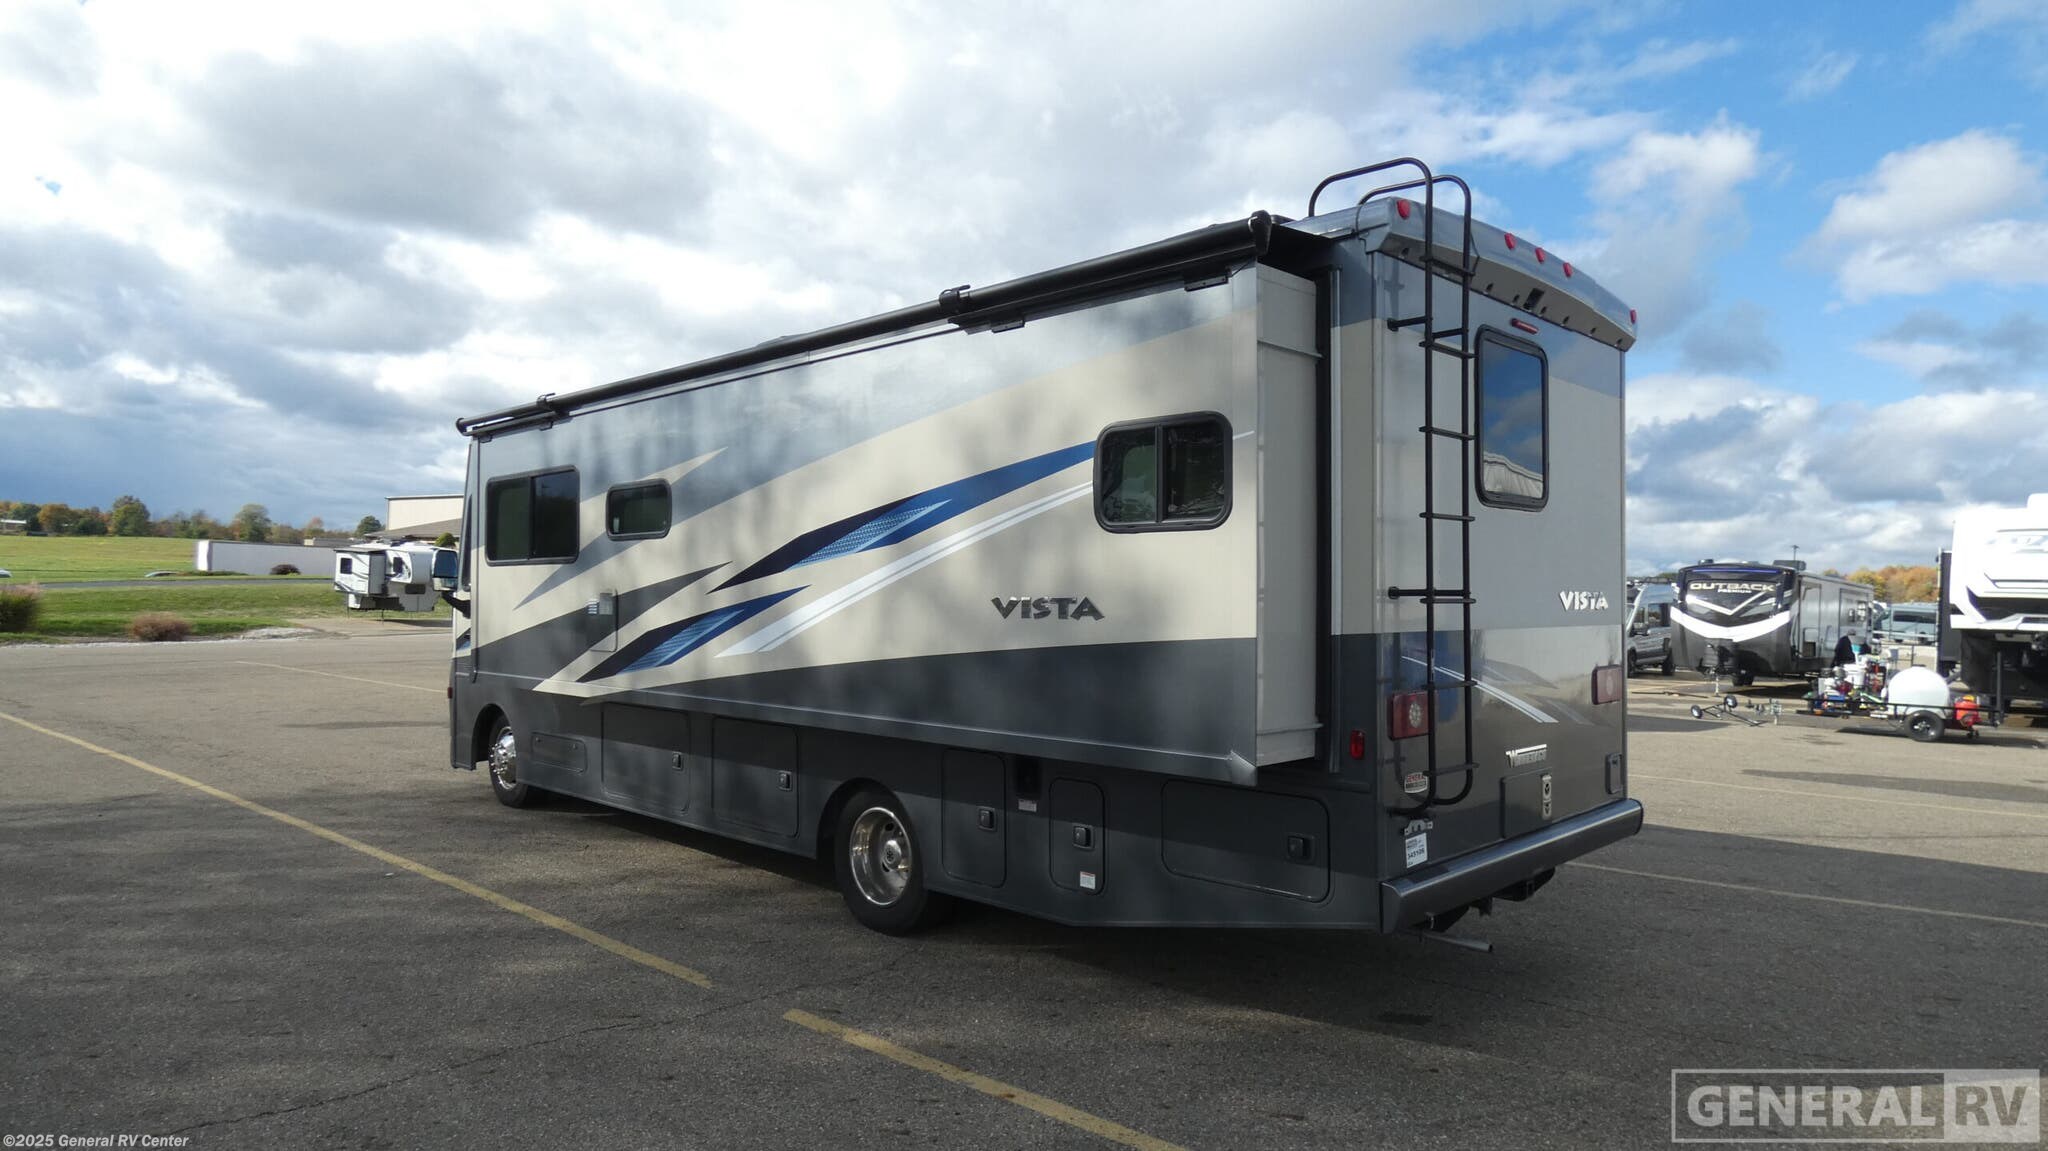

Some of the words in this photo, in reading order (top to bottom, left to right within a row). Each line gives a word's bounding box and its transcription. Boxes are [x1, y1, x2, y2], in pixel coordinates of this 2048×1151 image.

[1689, 582, 1775, 592] OUTBACK
[991, 596, 1105, 621] VISTA
[1559, 589, 1609, 611] VISTA
